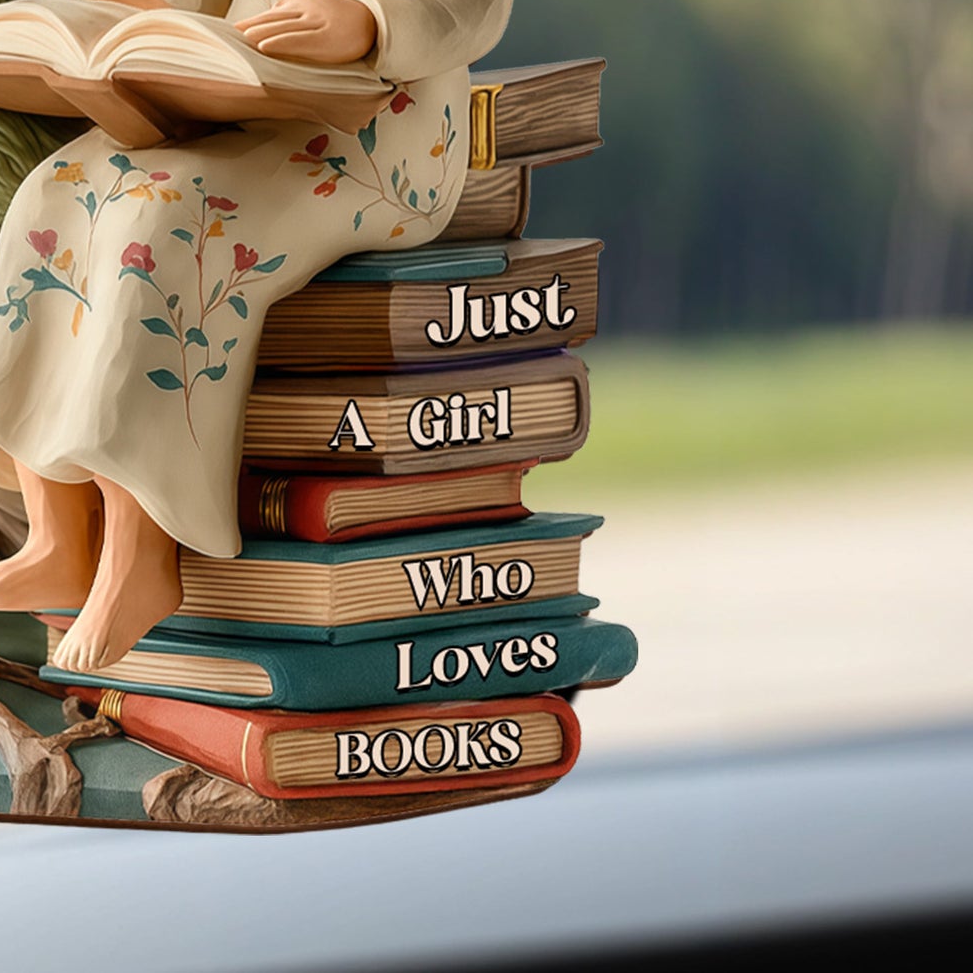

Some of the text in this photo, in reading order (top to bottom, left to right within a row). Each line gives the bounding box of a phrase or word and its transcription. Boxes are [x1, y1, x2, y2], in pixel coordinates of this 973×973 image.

[427, 275, 576, 345] Just
[329, 389, 512, 450] A Girl
[403, 556, 533, 609] Who
[395, 632, 557, 692] Loves
[335, 720, 522, 777] BOOKS
